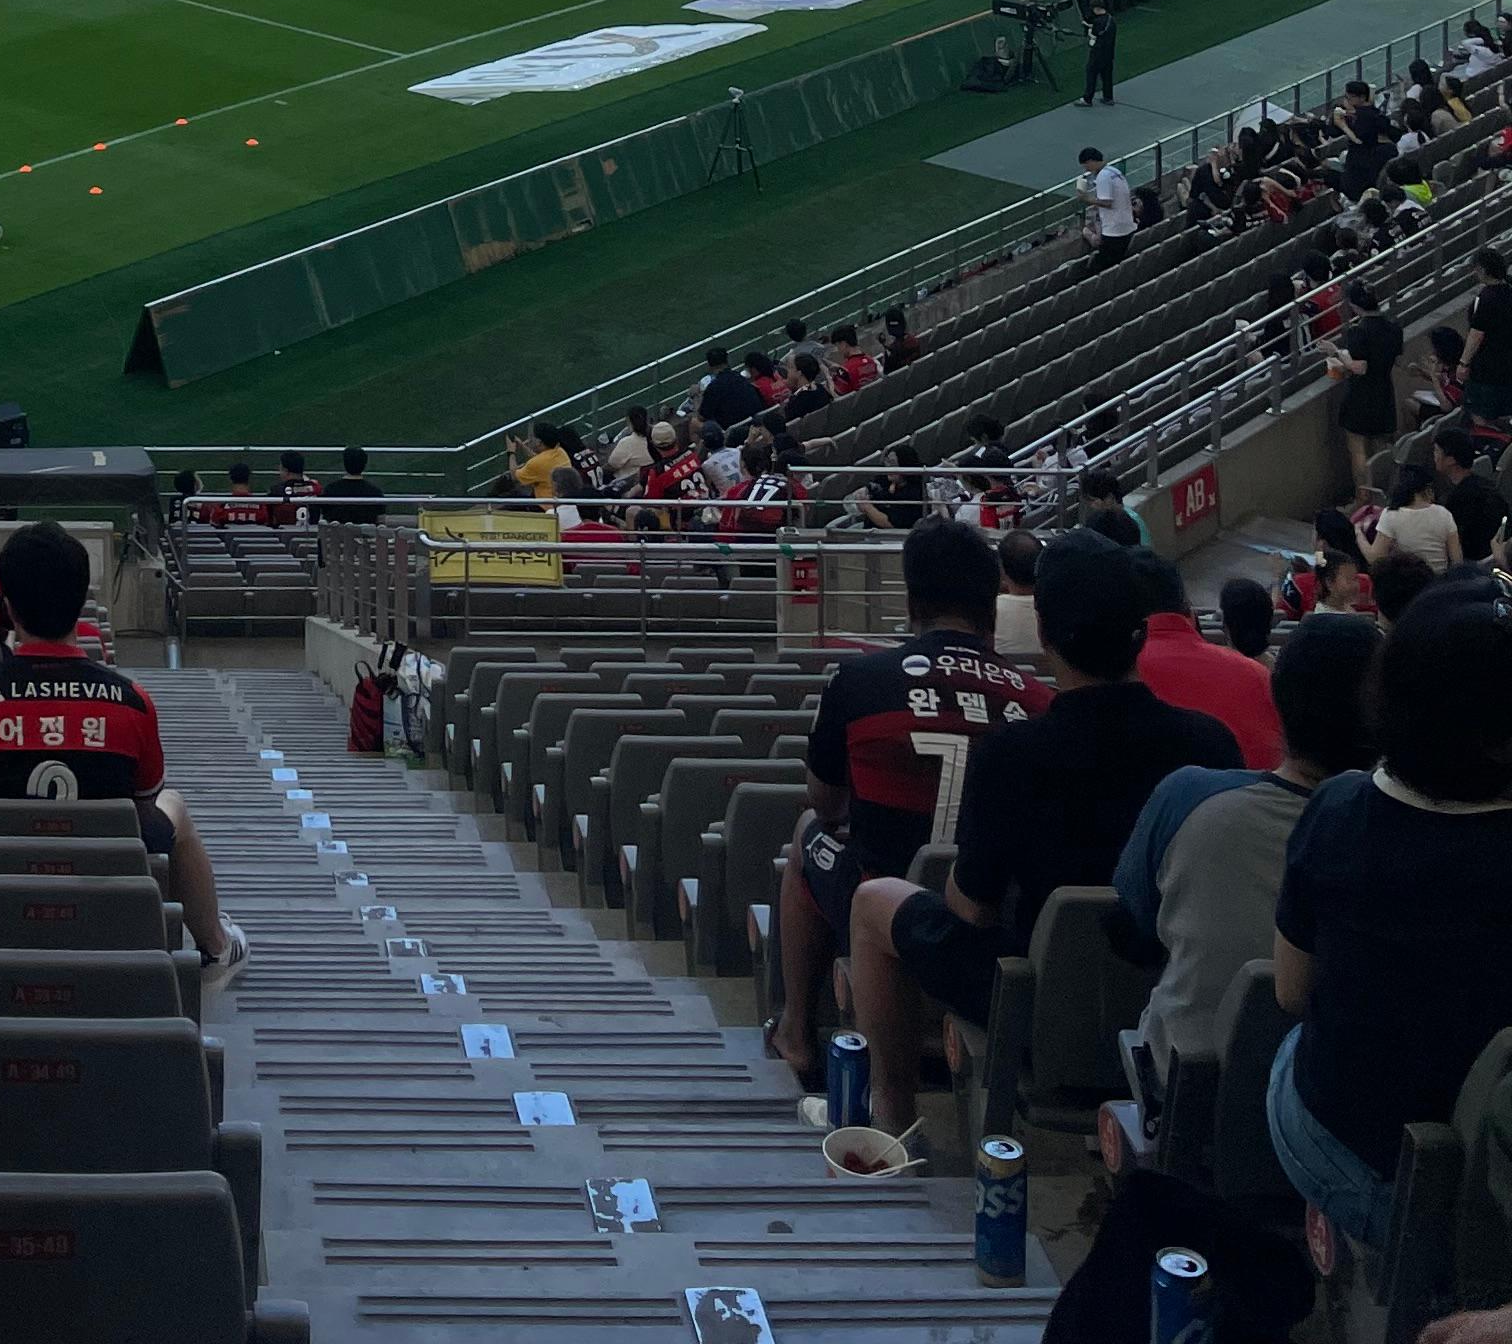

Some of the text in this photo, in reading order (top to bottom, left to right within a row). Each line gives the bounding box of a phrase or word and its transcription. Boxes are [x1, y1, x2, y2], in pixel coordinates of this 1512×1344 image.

[1185, 477, 1206, 516] AB
[936, 654, 1026, 691] 우리은행
[10, 681, 123, 703] LASHEVAN
[0, 715, 106, 748] 어정원
[909, 731, 970, 846] 7
